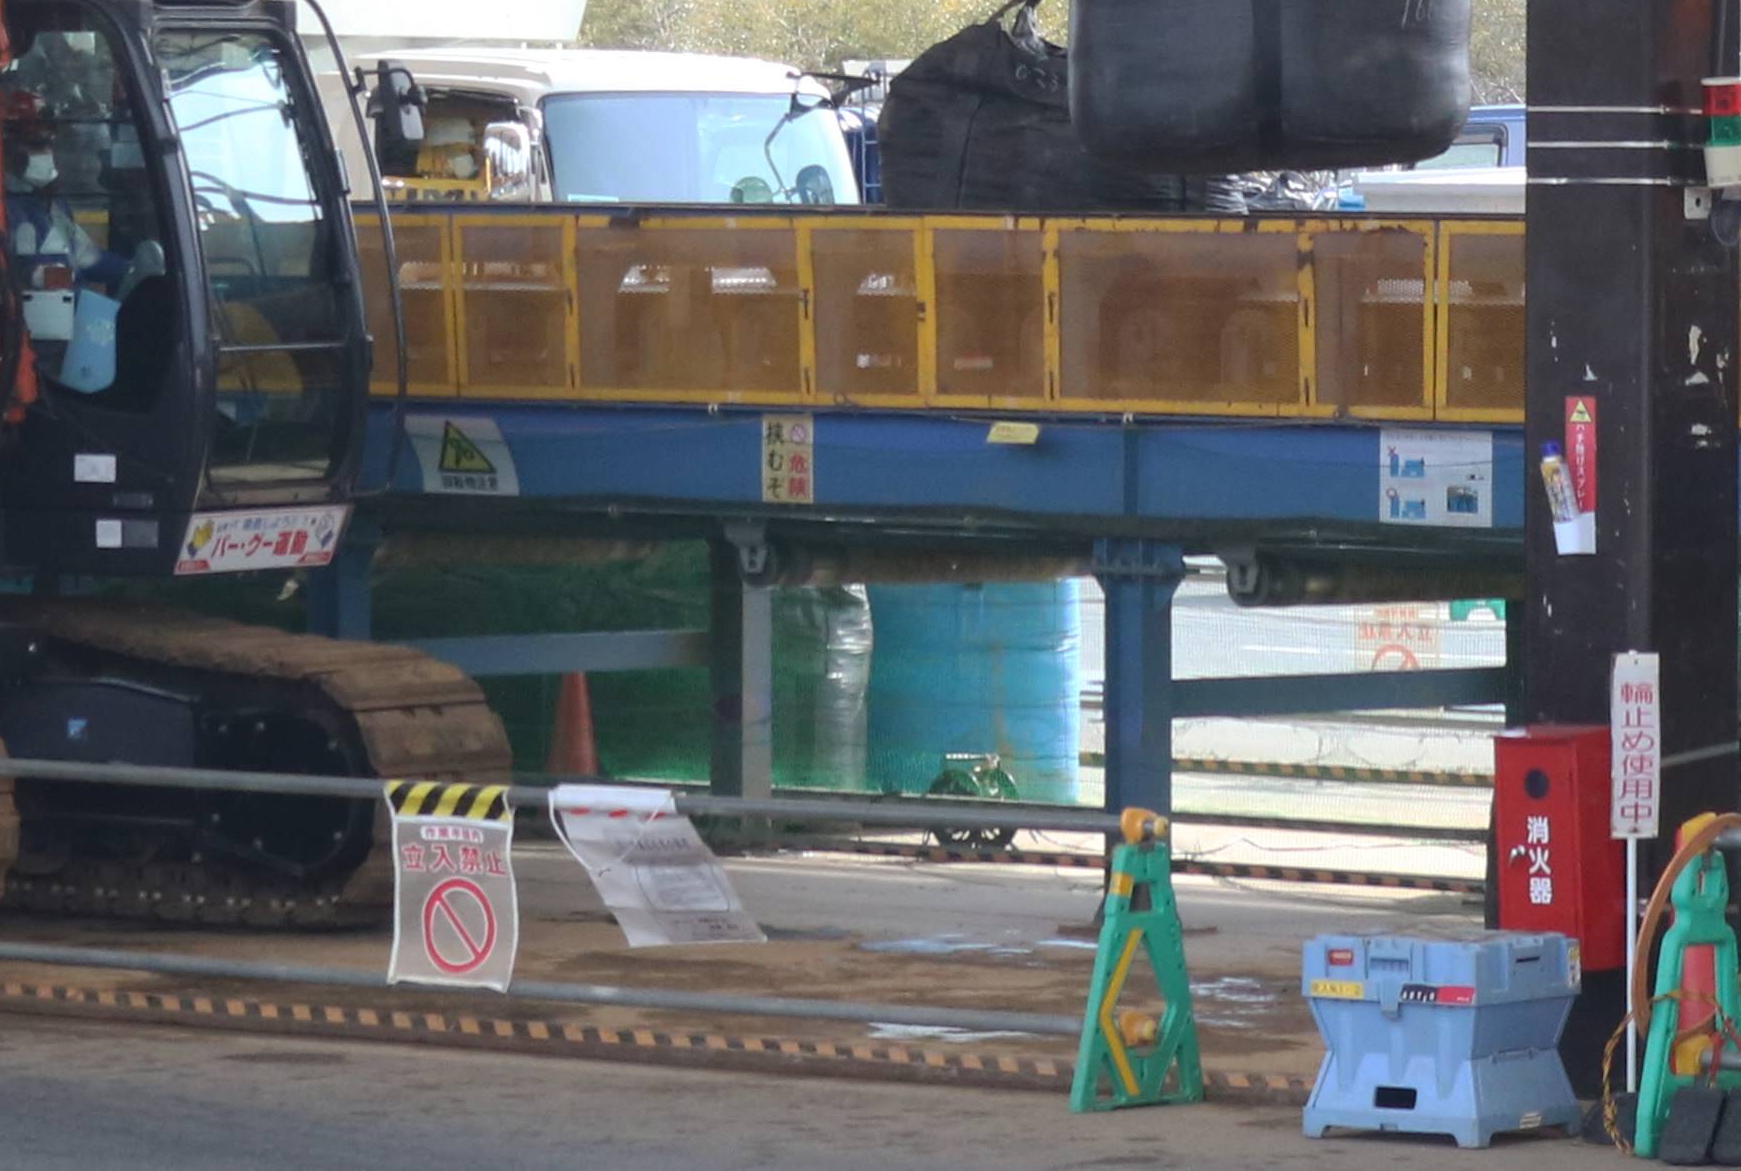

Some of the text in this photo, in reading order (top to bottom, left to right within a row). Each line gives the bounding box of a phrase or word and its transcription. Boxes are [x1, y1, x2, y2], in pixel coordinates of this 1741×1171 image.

[1619, 681, 1655, 825] 輪止め使用中
[400, 842, 507, 876] 立入禁止
[1526, 815, 1552, 905] 消火器
